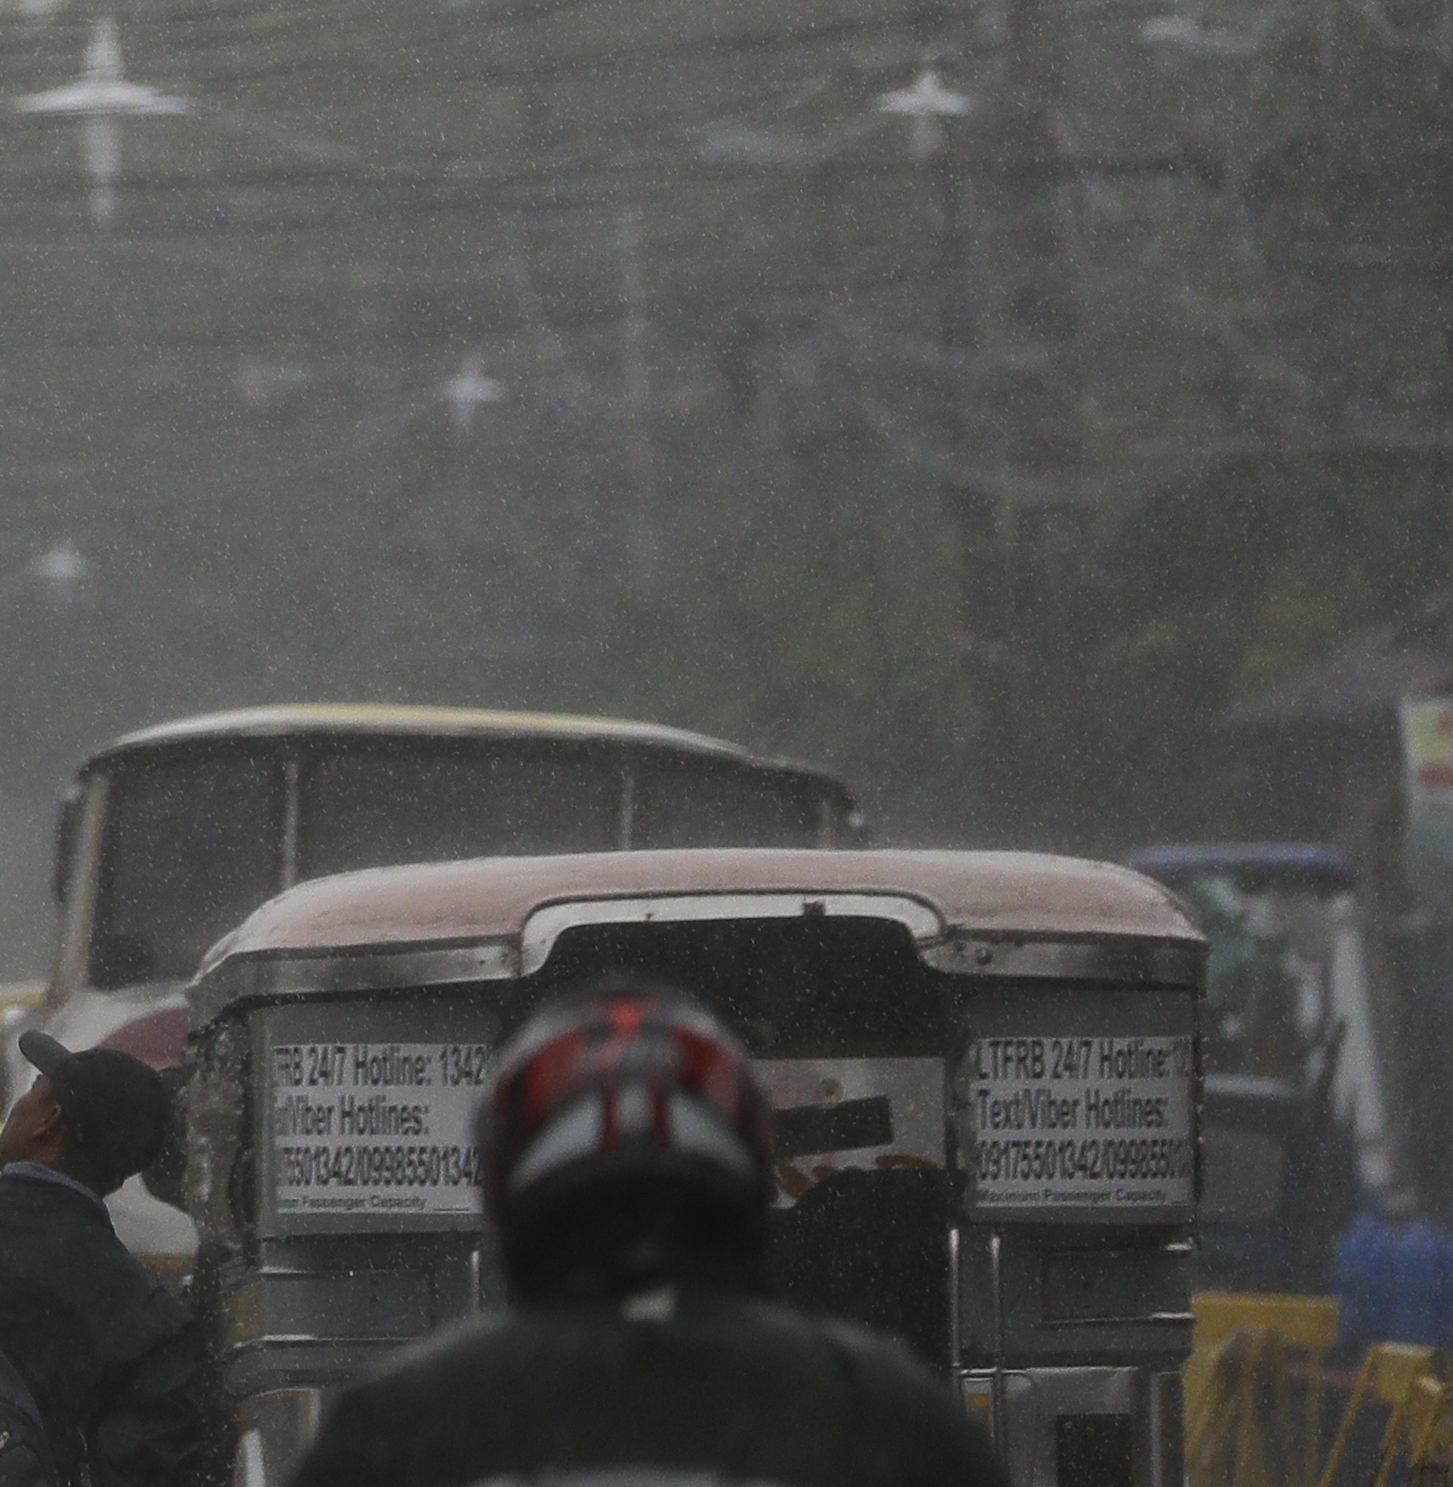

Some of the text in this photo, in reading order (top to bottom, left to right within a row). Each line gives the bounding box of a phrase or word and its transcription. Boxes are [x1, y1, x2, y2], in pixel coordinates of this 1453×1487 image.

[308, 1045, 345, 1086] 24/7
[353, 1044, 433, 1086] Hotline:
[440, 1045, 486, 1086] 1342
[975, 1038, 1044, 1080] LTFRB
[1051, 1038, 1093, 1080] 24/7
[339, 1093, 430, 1136] Hotlines:
[978, 1086, 1169, 1130] Text/Viber Hotlines:
